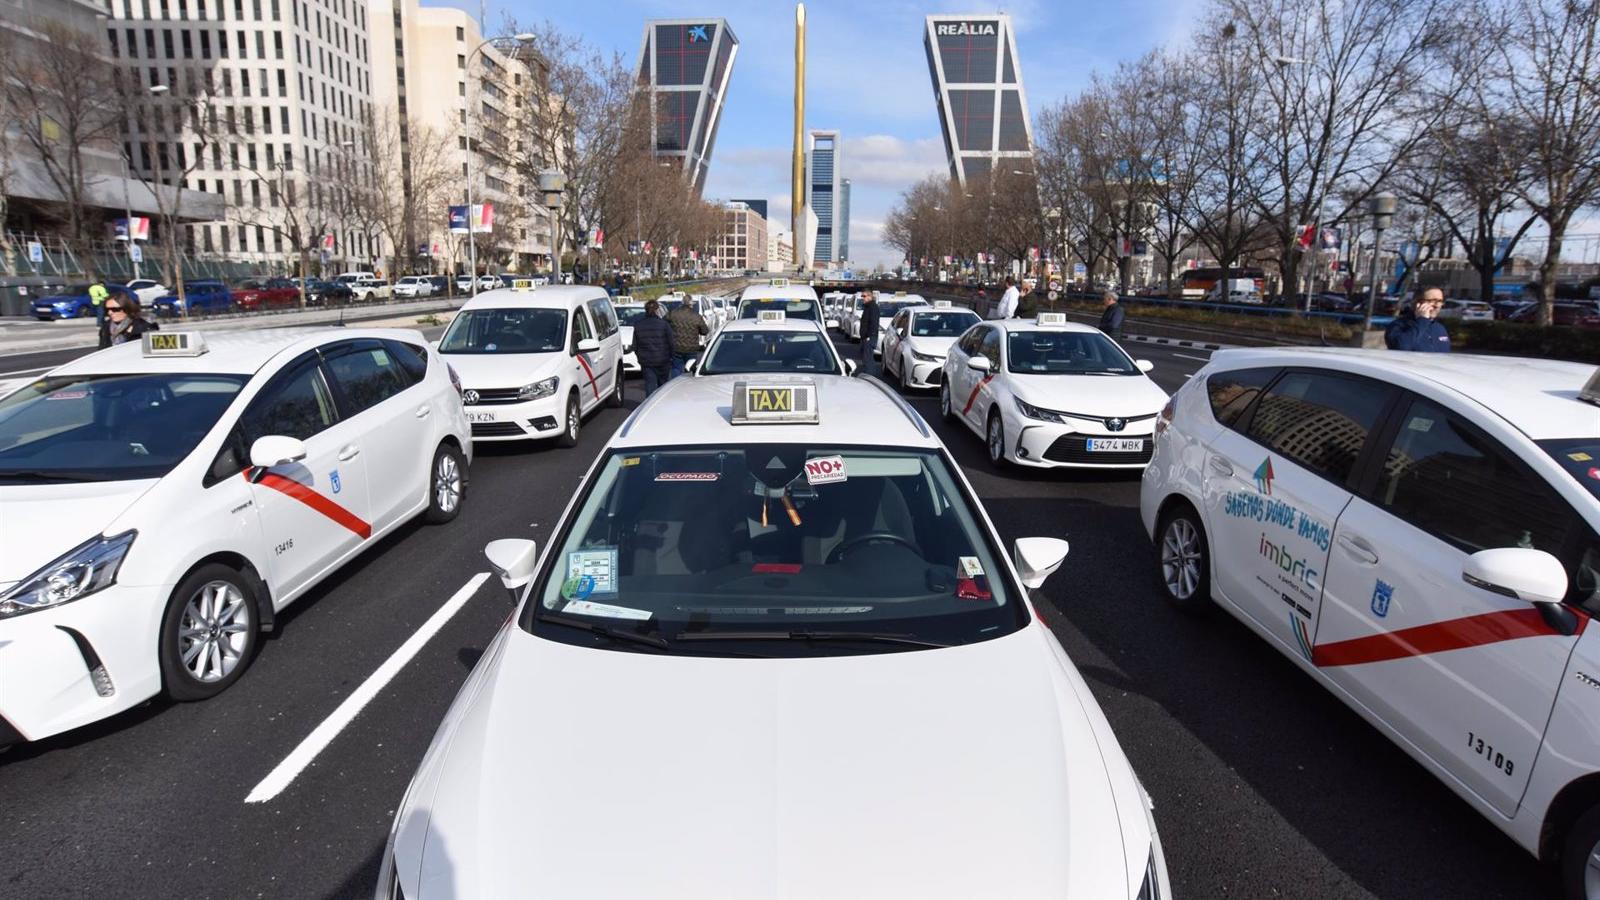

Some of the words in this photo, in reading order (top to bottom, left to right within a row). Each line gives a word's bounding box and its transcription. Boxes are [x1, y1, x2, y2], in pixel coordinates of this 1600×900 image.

[152, 335, 178, 349] TAXI
[750, 390, 791, 410] TAXI
[477, 413, 495, 421] KZN
[1093, 440, 1118, 450] 5474
[1121, 440, 1140, 450] MBK
[806, 460, 842, 475] NO+
[1225, 491, 1263, 522] SABEMOS
[1298, 512, 1329, 552] VAMOS
[1260, 532, 1317, 590] imbric
[1468, 732, 1514, 776] 13109
